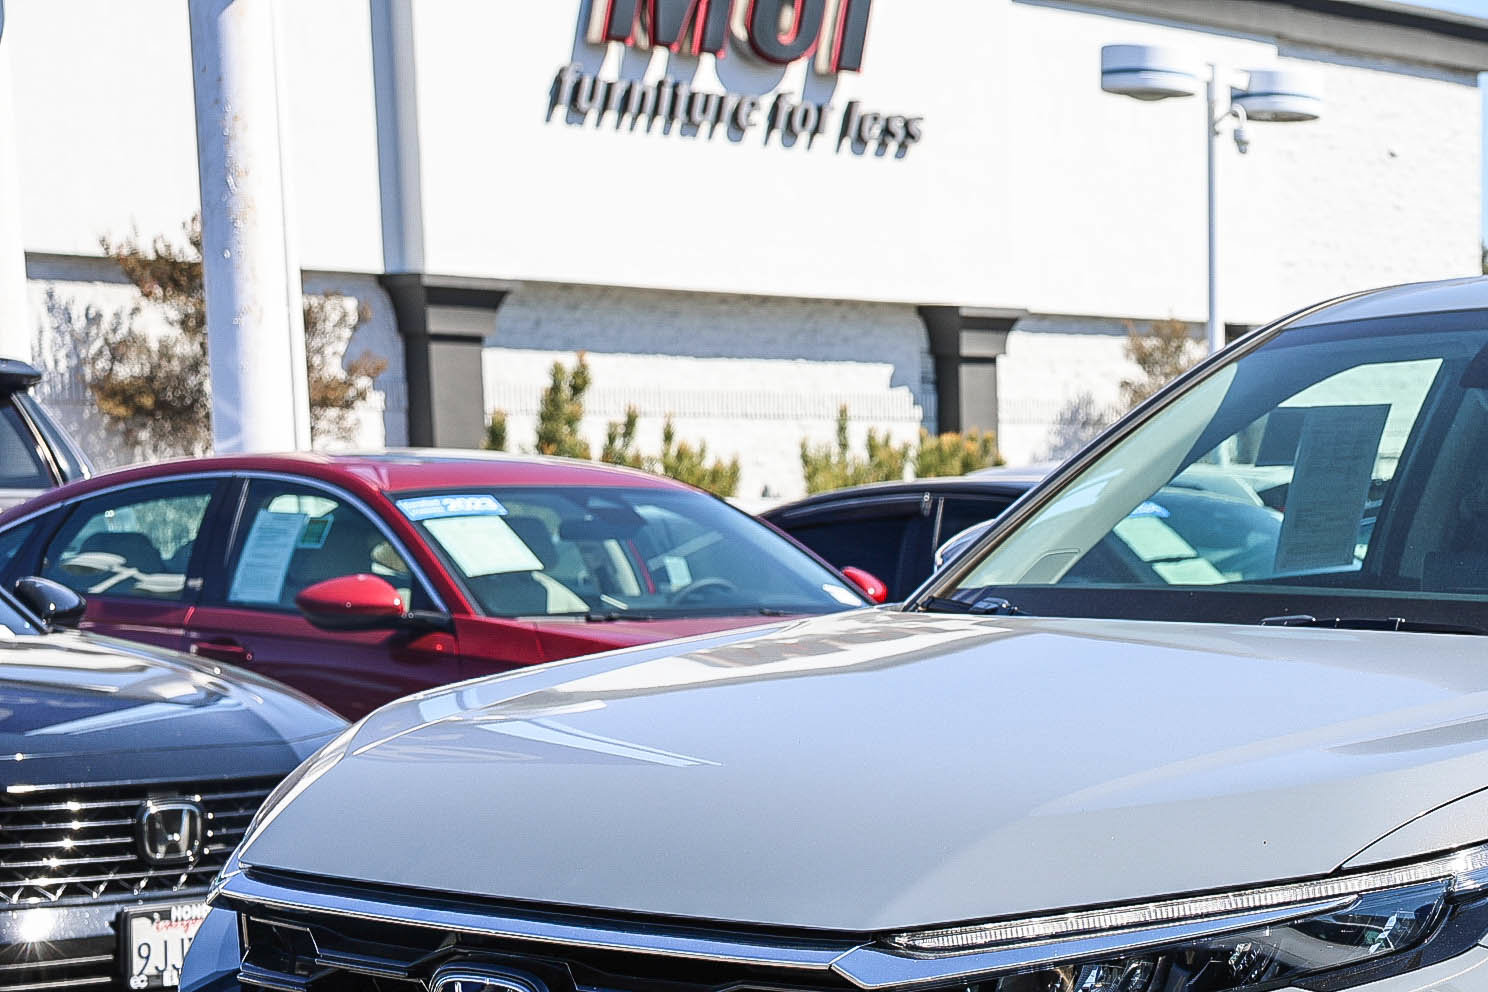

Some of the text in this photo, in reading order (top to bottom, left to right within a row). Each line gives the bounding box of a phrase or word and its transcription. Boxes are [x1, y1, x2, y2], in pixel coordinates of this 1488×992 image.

[546, 63, 923, 154] furniture for less
